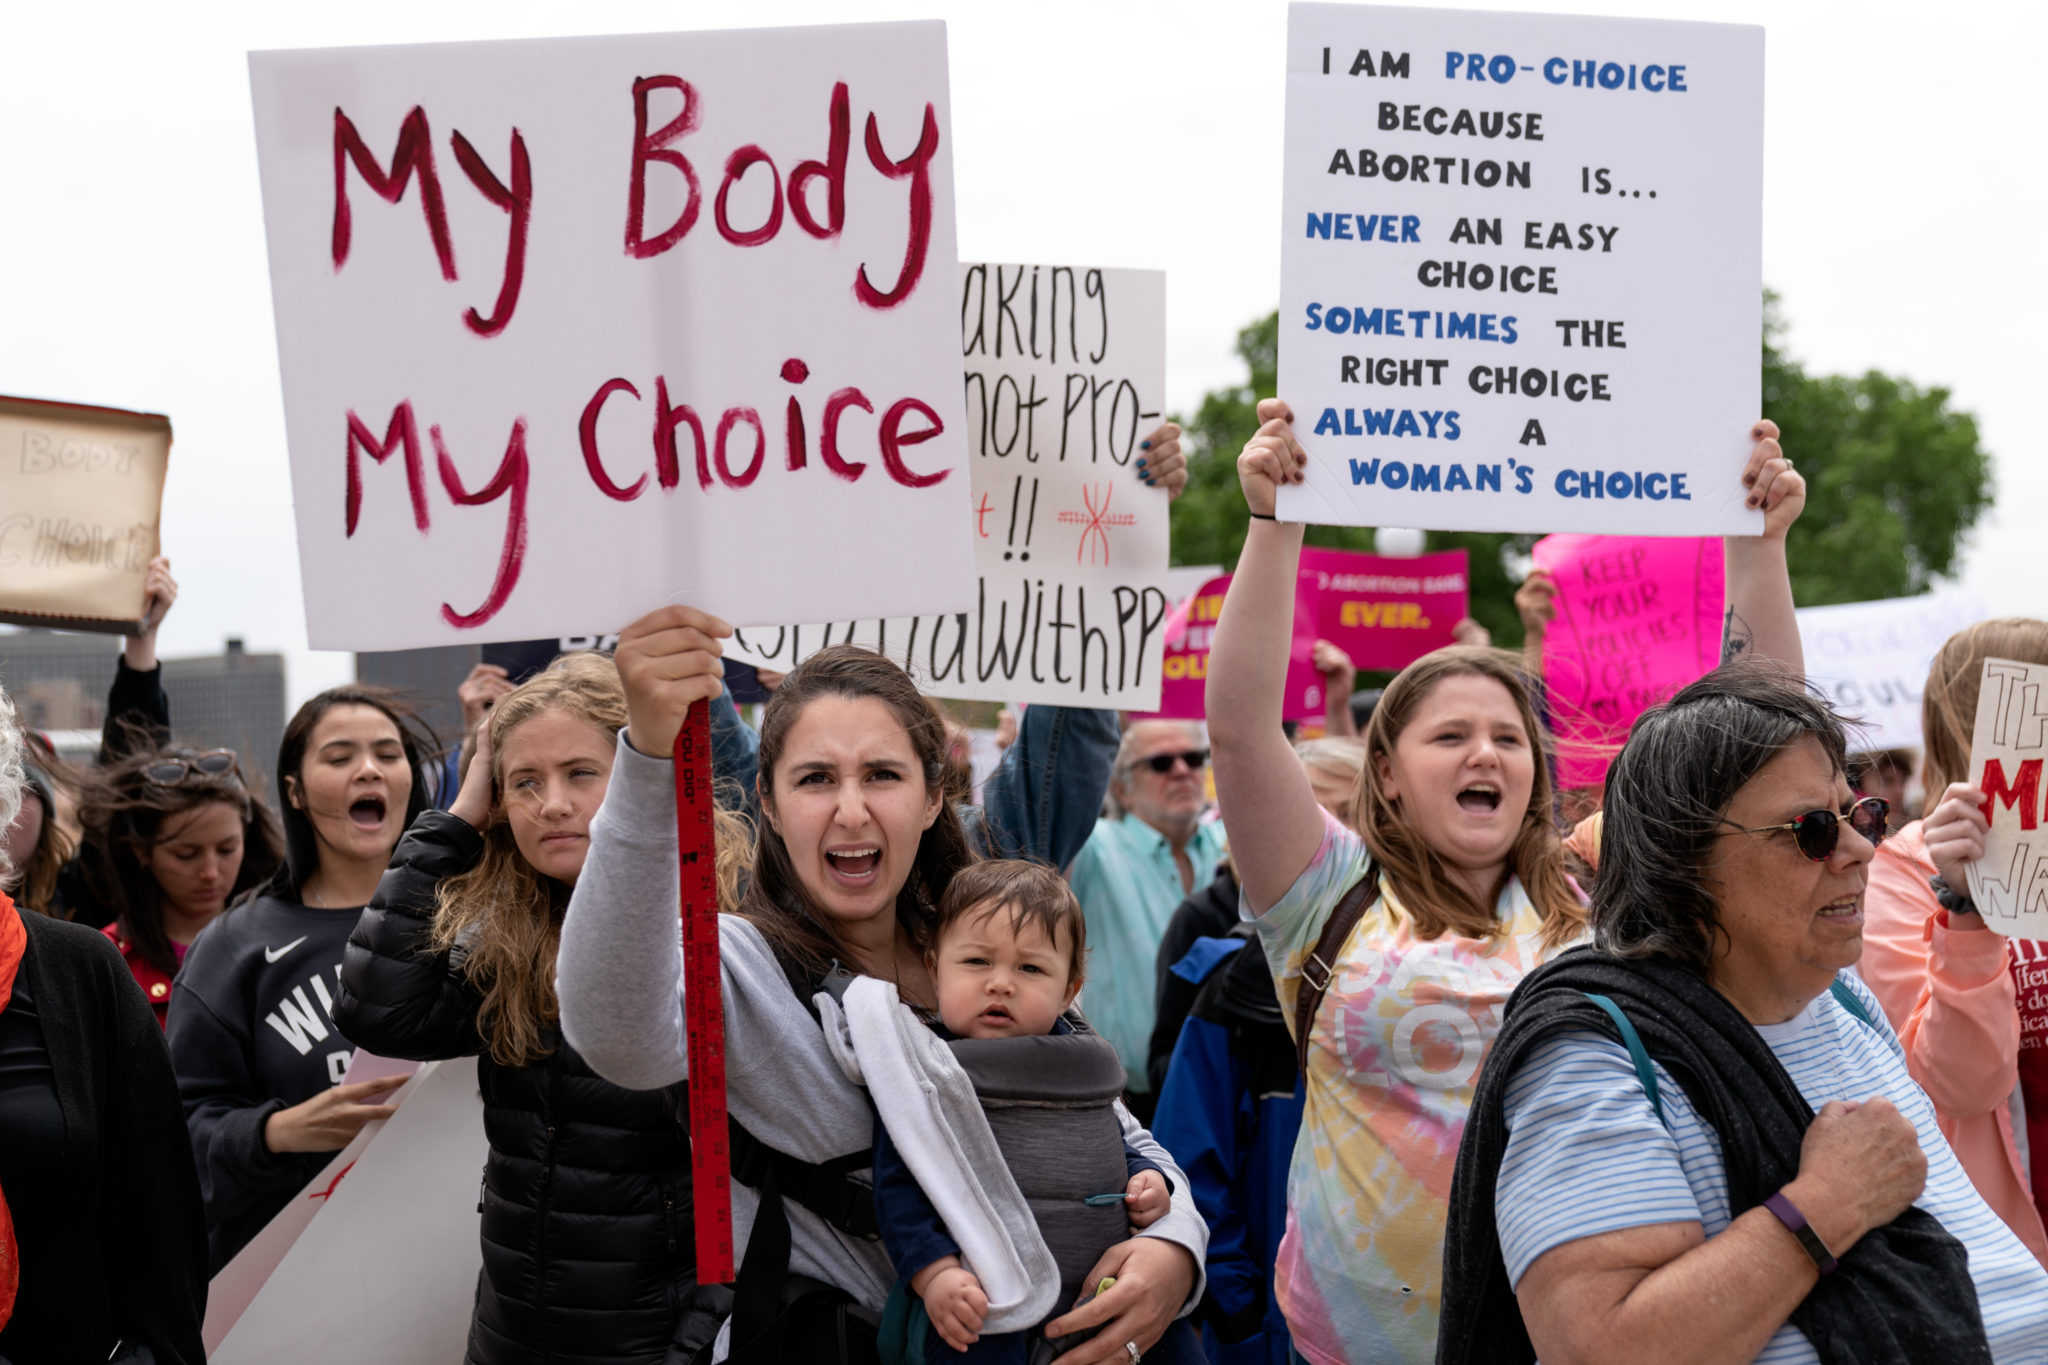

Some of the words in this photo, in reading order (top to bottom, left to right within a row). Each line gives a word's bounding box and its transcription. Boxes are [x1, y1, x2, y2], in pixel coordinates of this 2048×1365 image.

[1322, 47, 1331, 75] I
[1349, 49, 1411, 79] AM
[1446, 51, 1688, 93] PRO-CHOICE
[1378, 102, 1545, 142] BECAUSE
[1328, 149, 1532, 189] ABORTION
[1582, 167, 1658, 199] IS...
[332, 106, 533, 339] My
[624, 74, 941, 311] Body
[1306, 212, 1422, 244] NEVER
[1449, 218, 1503, 246] AN
[1525, 222, 1620, 253] EASY
[1417, 260, 1558, 295] CHOICE
[1305, 302, 1519, 345] SOMETIMES
[1556, 320, 1628, 349] THE
[1341, 356, 1450, 387] RIGHT
[1468, 366, 1613, 403] CHOICE
[1314, 407, 1462, 441] ALWAYS
[1519, 419, 1548, 446] A
[20, 429, 141, 475] BODY
[347, 400, 532, 629] My
[580, 358, 954, 503] Choice
[1349, 458, 1535, 495] WOMAN'S
[1554, 469, 1693, 502] CHOICE
[1580, 545, 1645, 589] KEEP
[1582, 580, 1661, 625] YOUR
[682, 726, 694, 763] YOU
